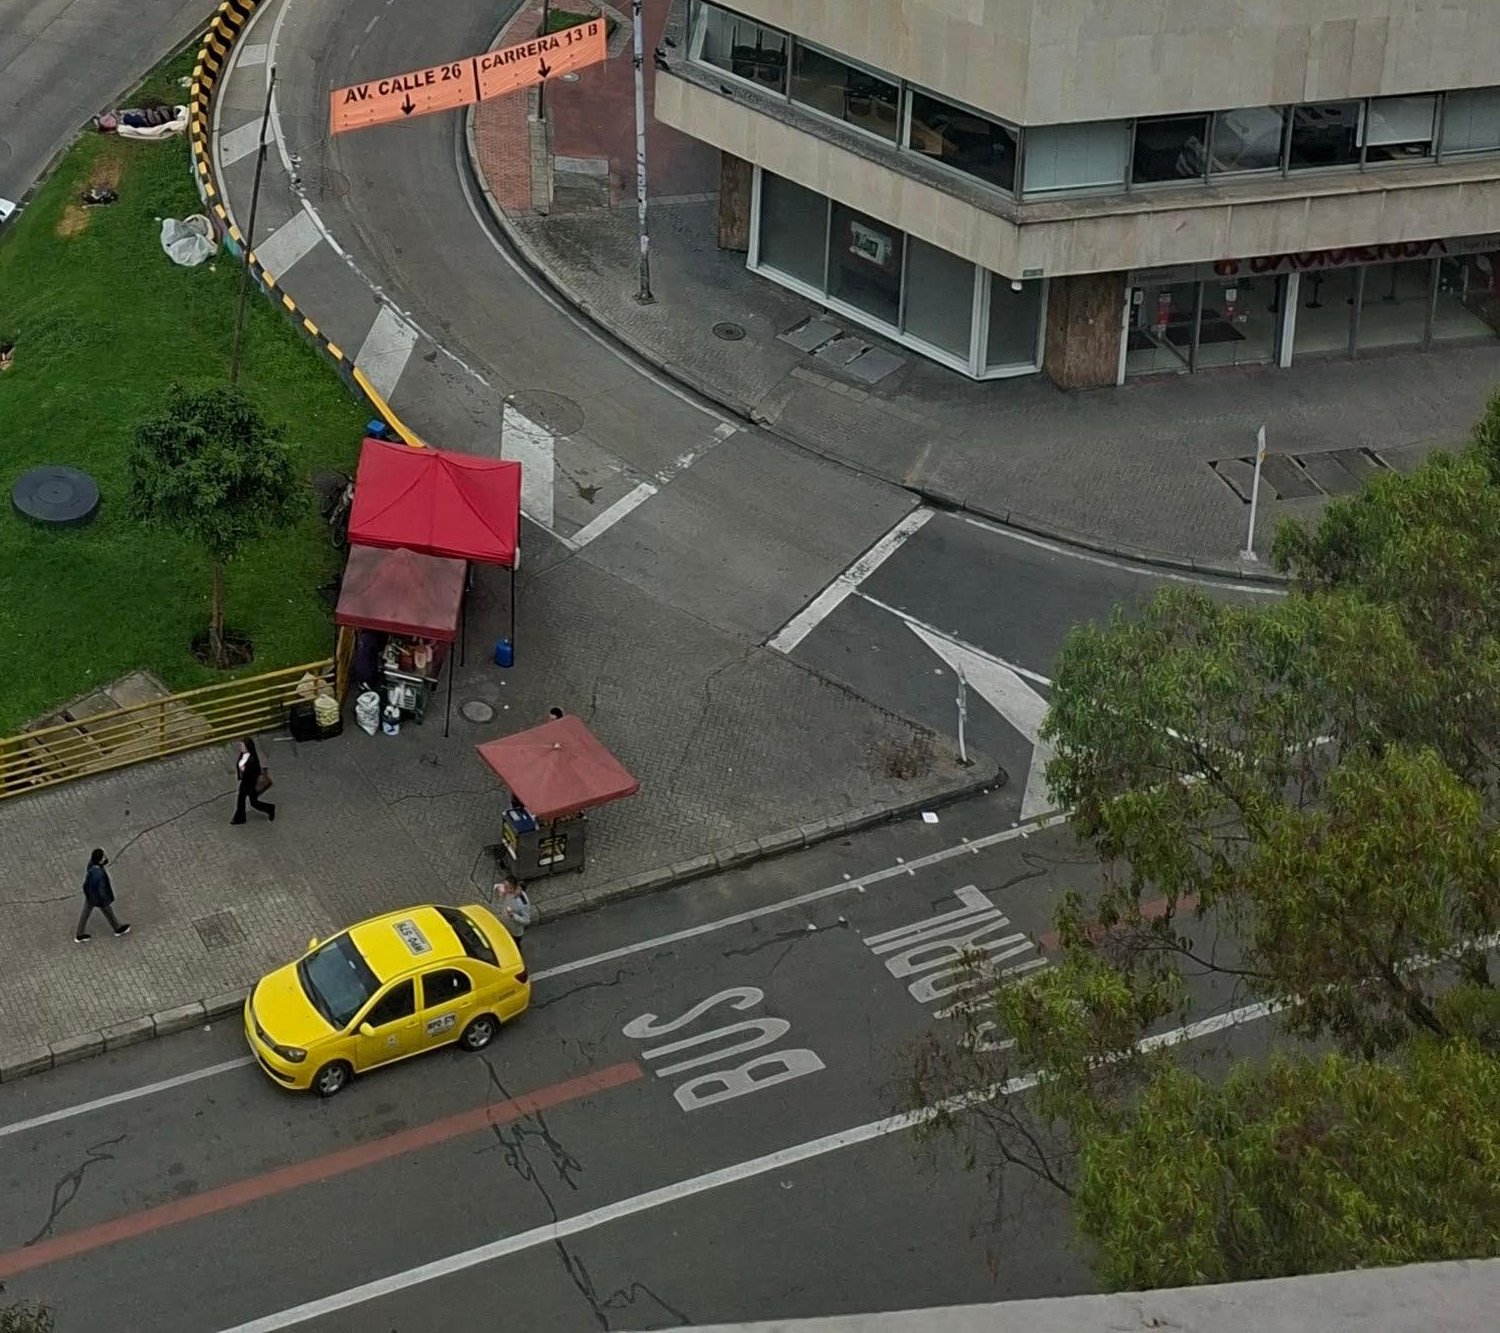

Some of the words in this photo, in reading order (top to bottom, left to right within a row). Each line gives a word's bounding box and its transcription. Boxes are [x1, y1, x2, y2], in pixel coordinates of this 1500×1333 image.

[480, 36, 560, 71] CARRERA
[565, 27, 584, 47] 13
[588, 23, 599, 37] B
[343, 85, 373, 105] AV.
[378, 69, 436, 97] CALLE
[440, 63, 463, 82] 26
[621, 985, 826, 1113] BUS
